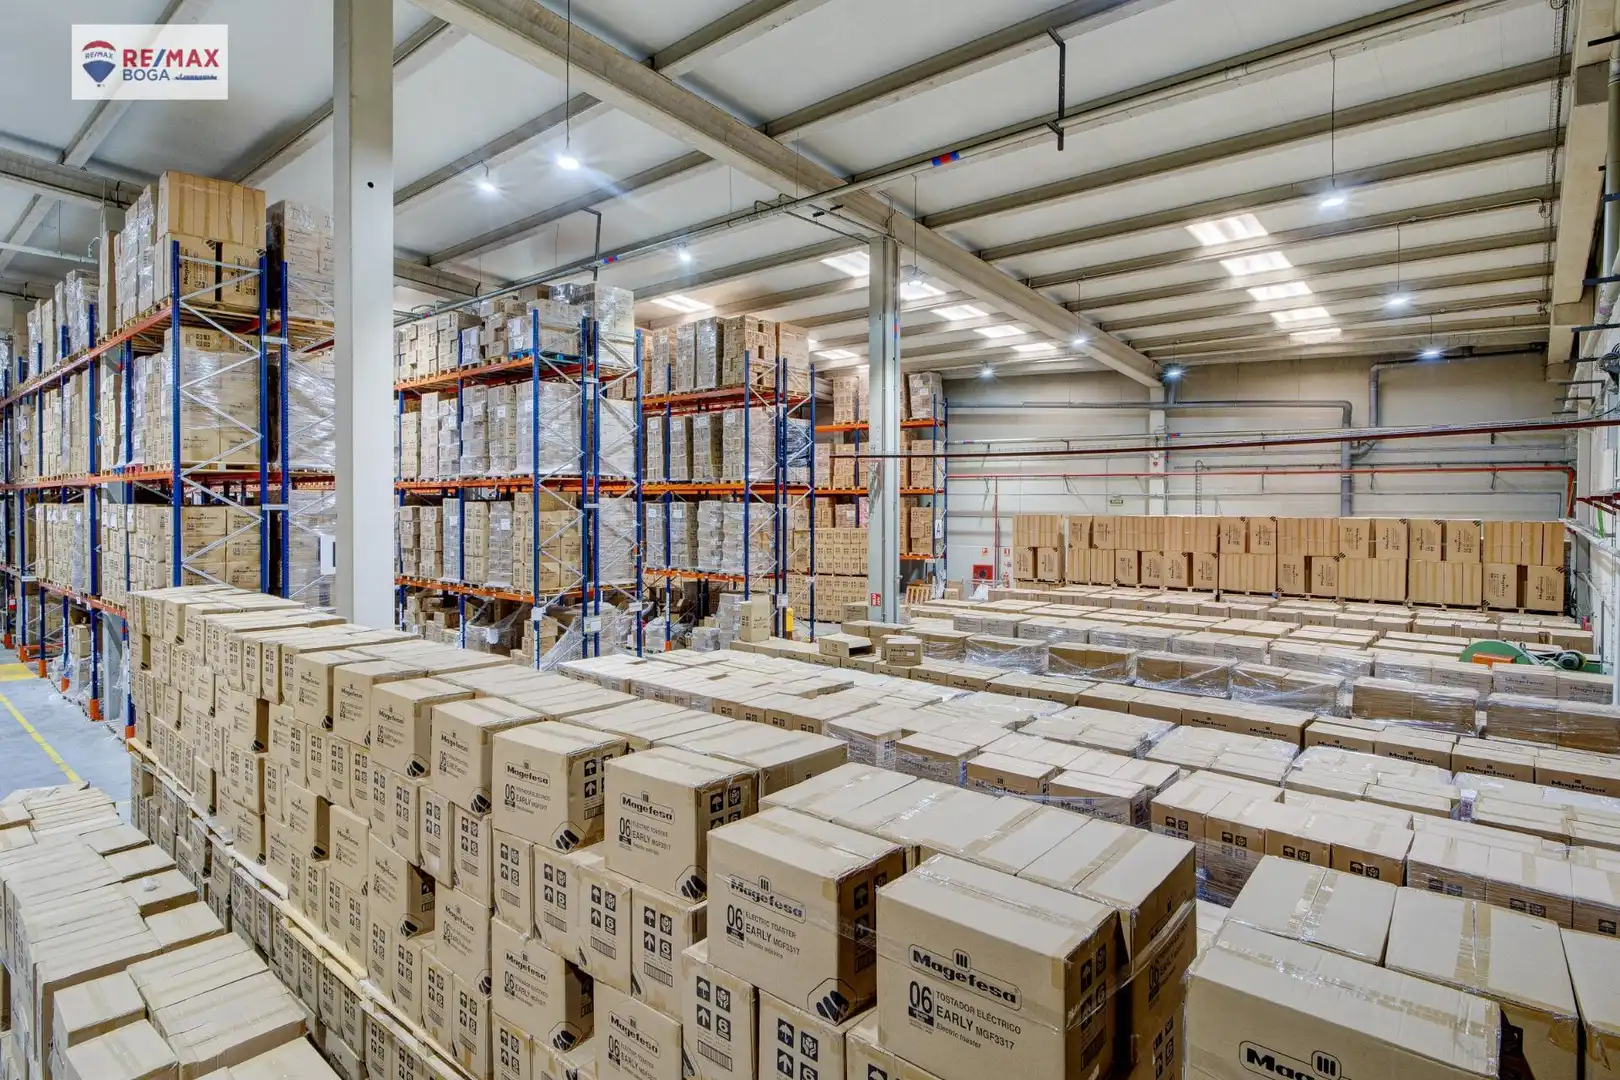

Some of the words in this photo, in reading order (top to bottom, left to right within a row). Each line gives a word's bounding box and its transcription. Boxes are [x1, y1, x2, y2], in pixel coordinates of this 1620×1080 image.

[507, 764, 549, 785] Magefesa
[504, 783, 516, 801] 06
[622, 796, 673, 821] Magefesa
[619, 817, 632, 838] 06
[632, 830, 651, 844] EARLY
[729, 877, 804, 919] Magefesa
[727, 903, 743, 931] 06
[745, 911, 770, 928] ELECTRIC
[771, 922, 797, 939] TOASTER
[745, 923, 772, 943] EARLY
[505, 952, 547, 981] Magefesa
[912, 949, 1017, 1004] Magefesa
[504, 970, 515, 990] 06
[909, 981, 933, 1014] 06
[718, 1017, 730, 1034] 6
[936, 991, 975, 1016] TOSTADOR
[977, 1009, 1022, 1035] ELÉCTRICO
[610, 1014, 659, 1054] Magefesa
[936, 1005, 974, 1031] EARLY
[975, 1025, 1016, 1051] MGF3317
[936, 1023, 959, 1039] Electric
[608, 1035, 620, 1058] 06
